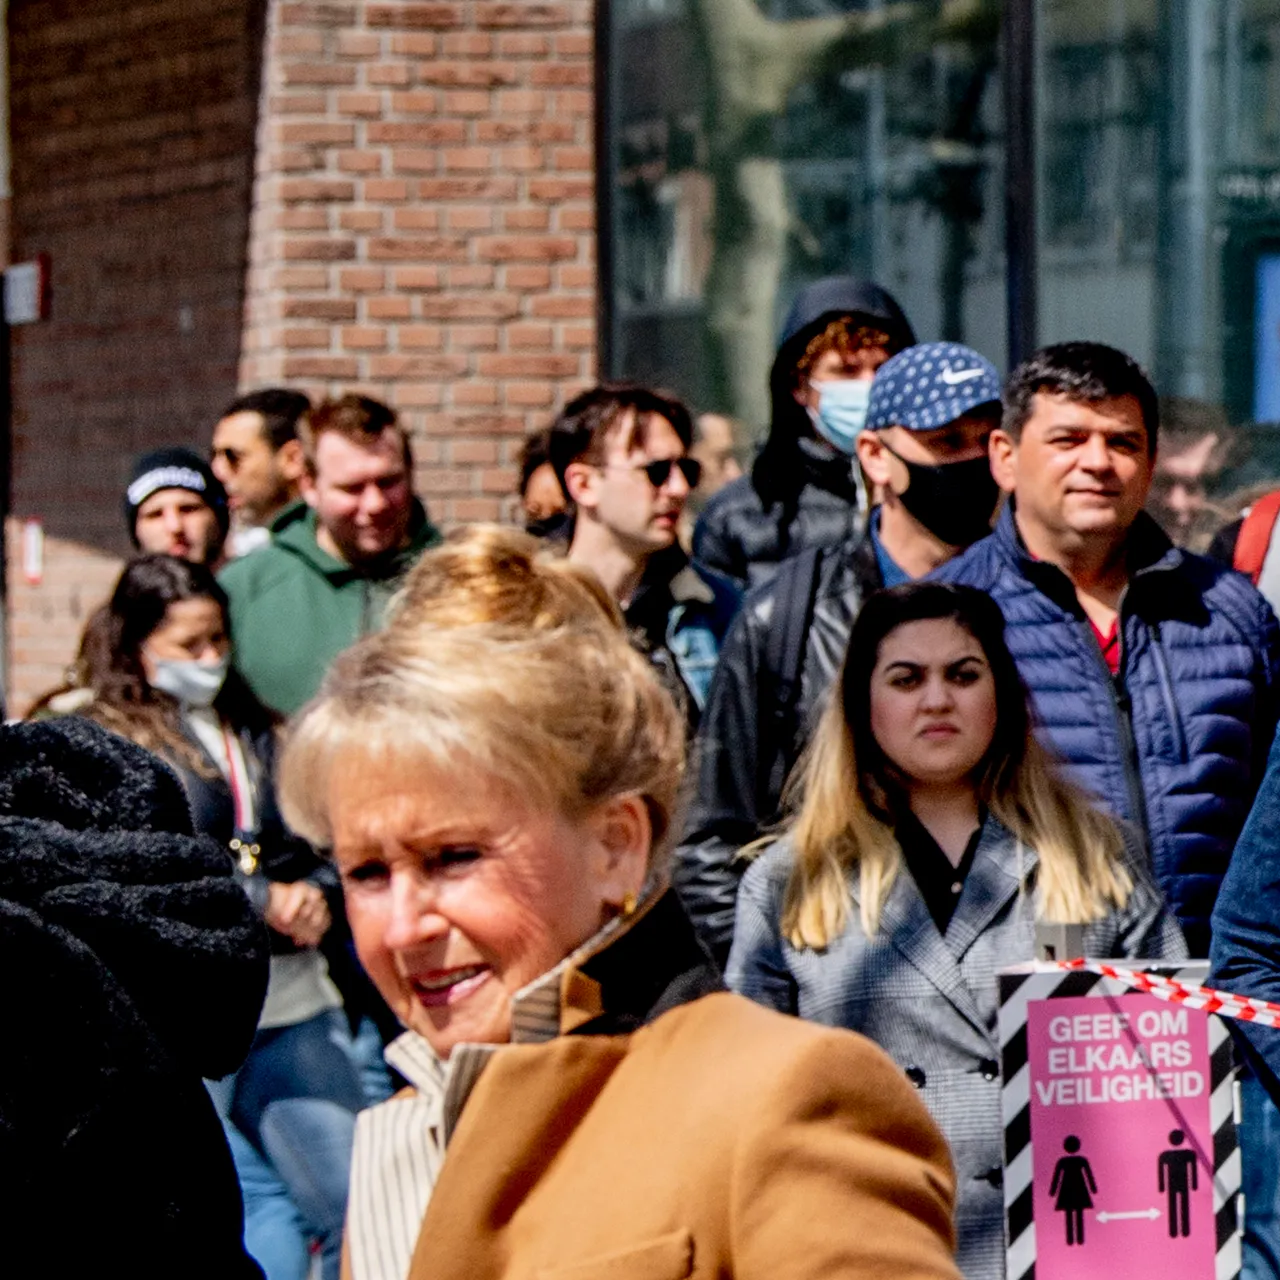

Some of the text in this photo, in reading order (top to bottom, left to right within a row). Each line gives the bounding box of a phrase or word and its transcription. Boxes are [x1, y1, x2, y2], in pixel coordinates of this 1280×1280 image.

[1049, 1009, 1188, 1043] GEEF OM
[1048, 1040, 1192, 1074] ELKAARS
[1034, 1071, 1204, 1106] VEILIGHEID
